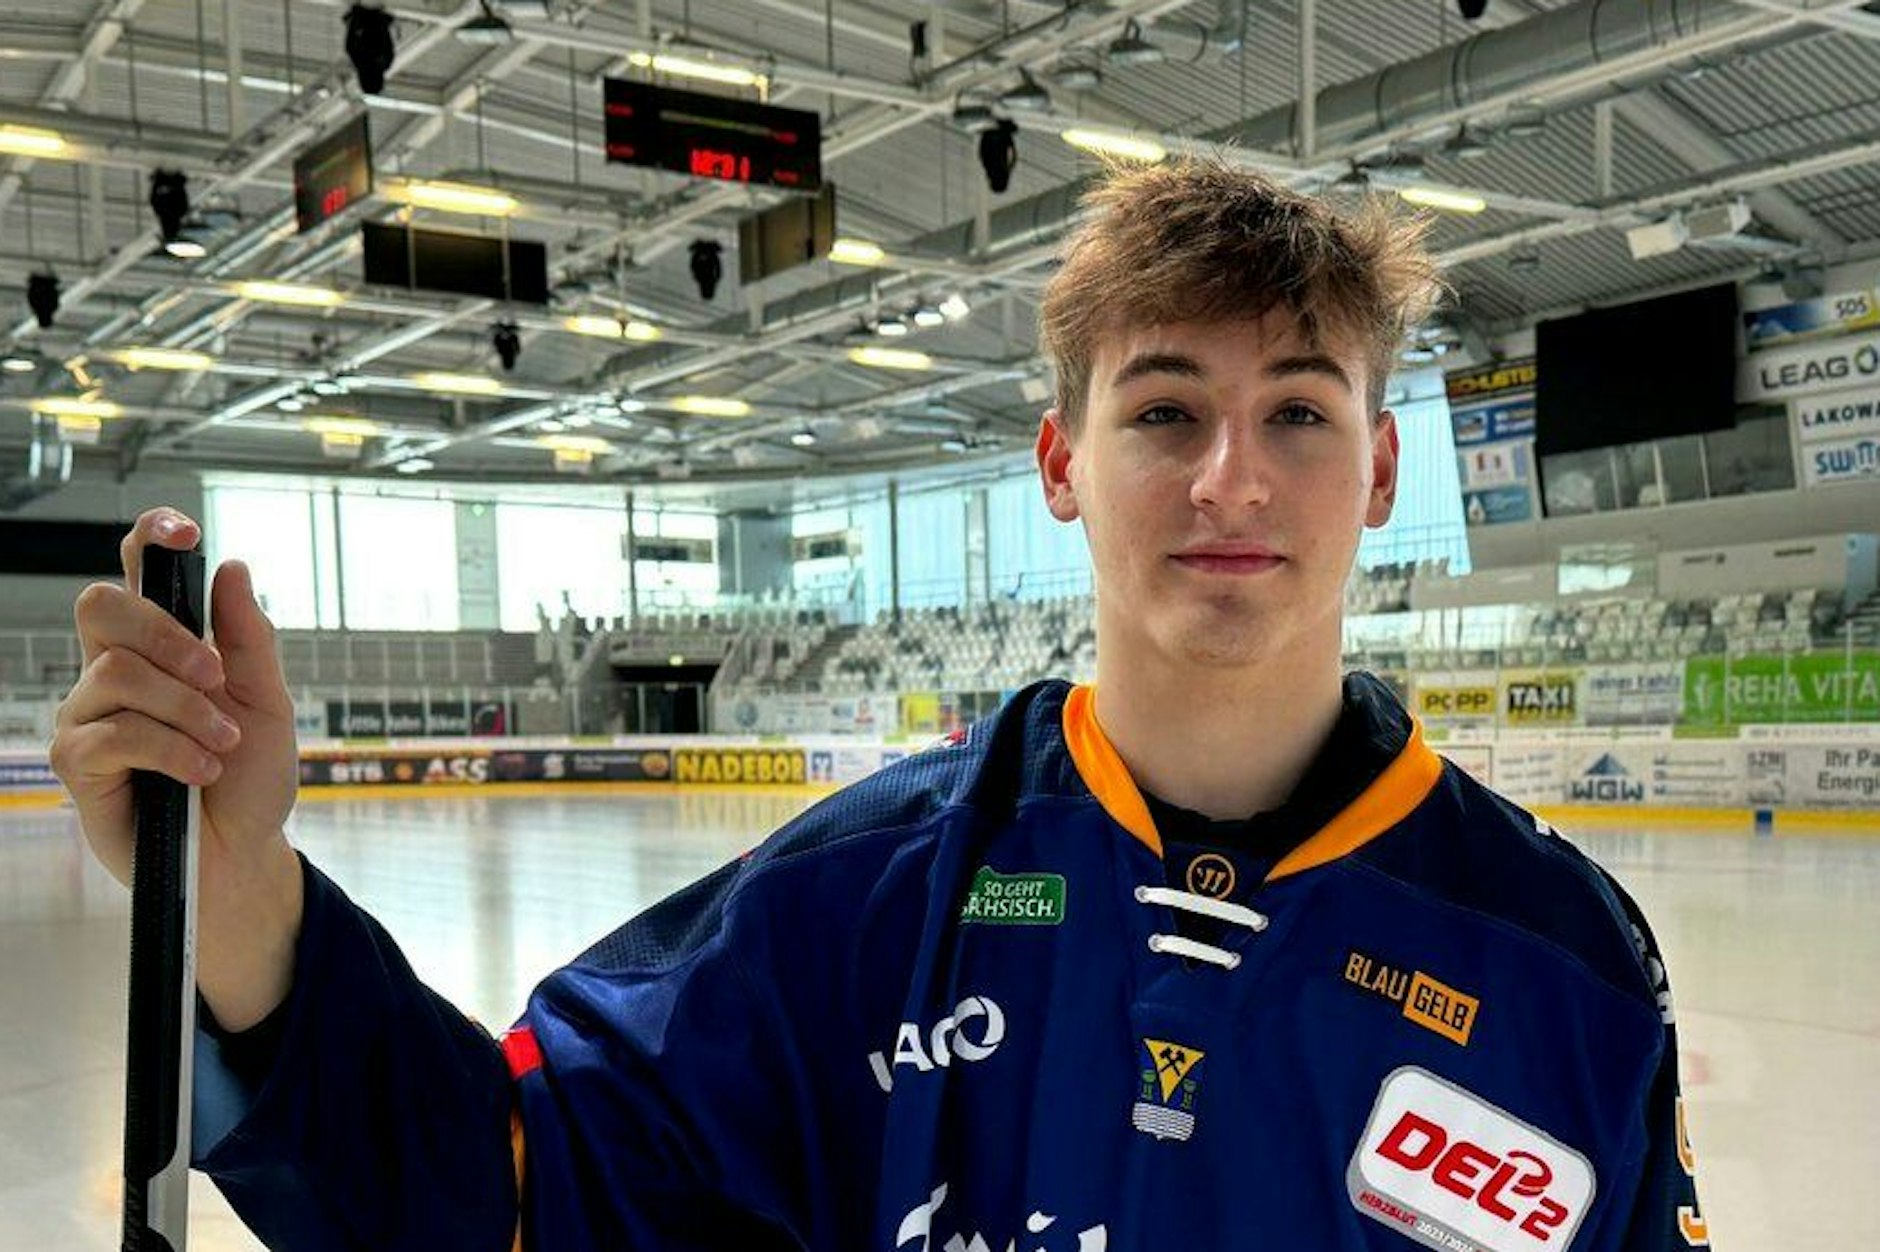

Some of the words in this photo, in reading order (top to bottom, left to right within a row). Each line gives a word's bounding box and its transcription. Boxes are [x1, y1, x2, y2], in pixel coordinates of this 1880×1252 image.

[1761, 356, 1849, 390] LEAG
[1510, 685, 1571, 709] TAXI
[1726, 675, 1803, 701] REHA
[423, 757, 489, 785] ASS
[676, 753, 806, 784] NADEBOR
[1825, 750, 1851, 768] Ihr
[1571, 779, 1644, 801] WGW
[984, 881, 1003, 898] SO
[1004, 881, 1046, 898] GEHT
[1344, 952, 1408, 1001] BLAU
[1413, 983, 1469, 1032] GELB
